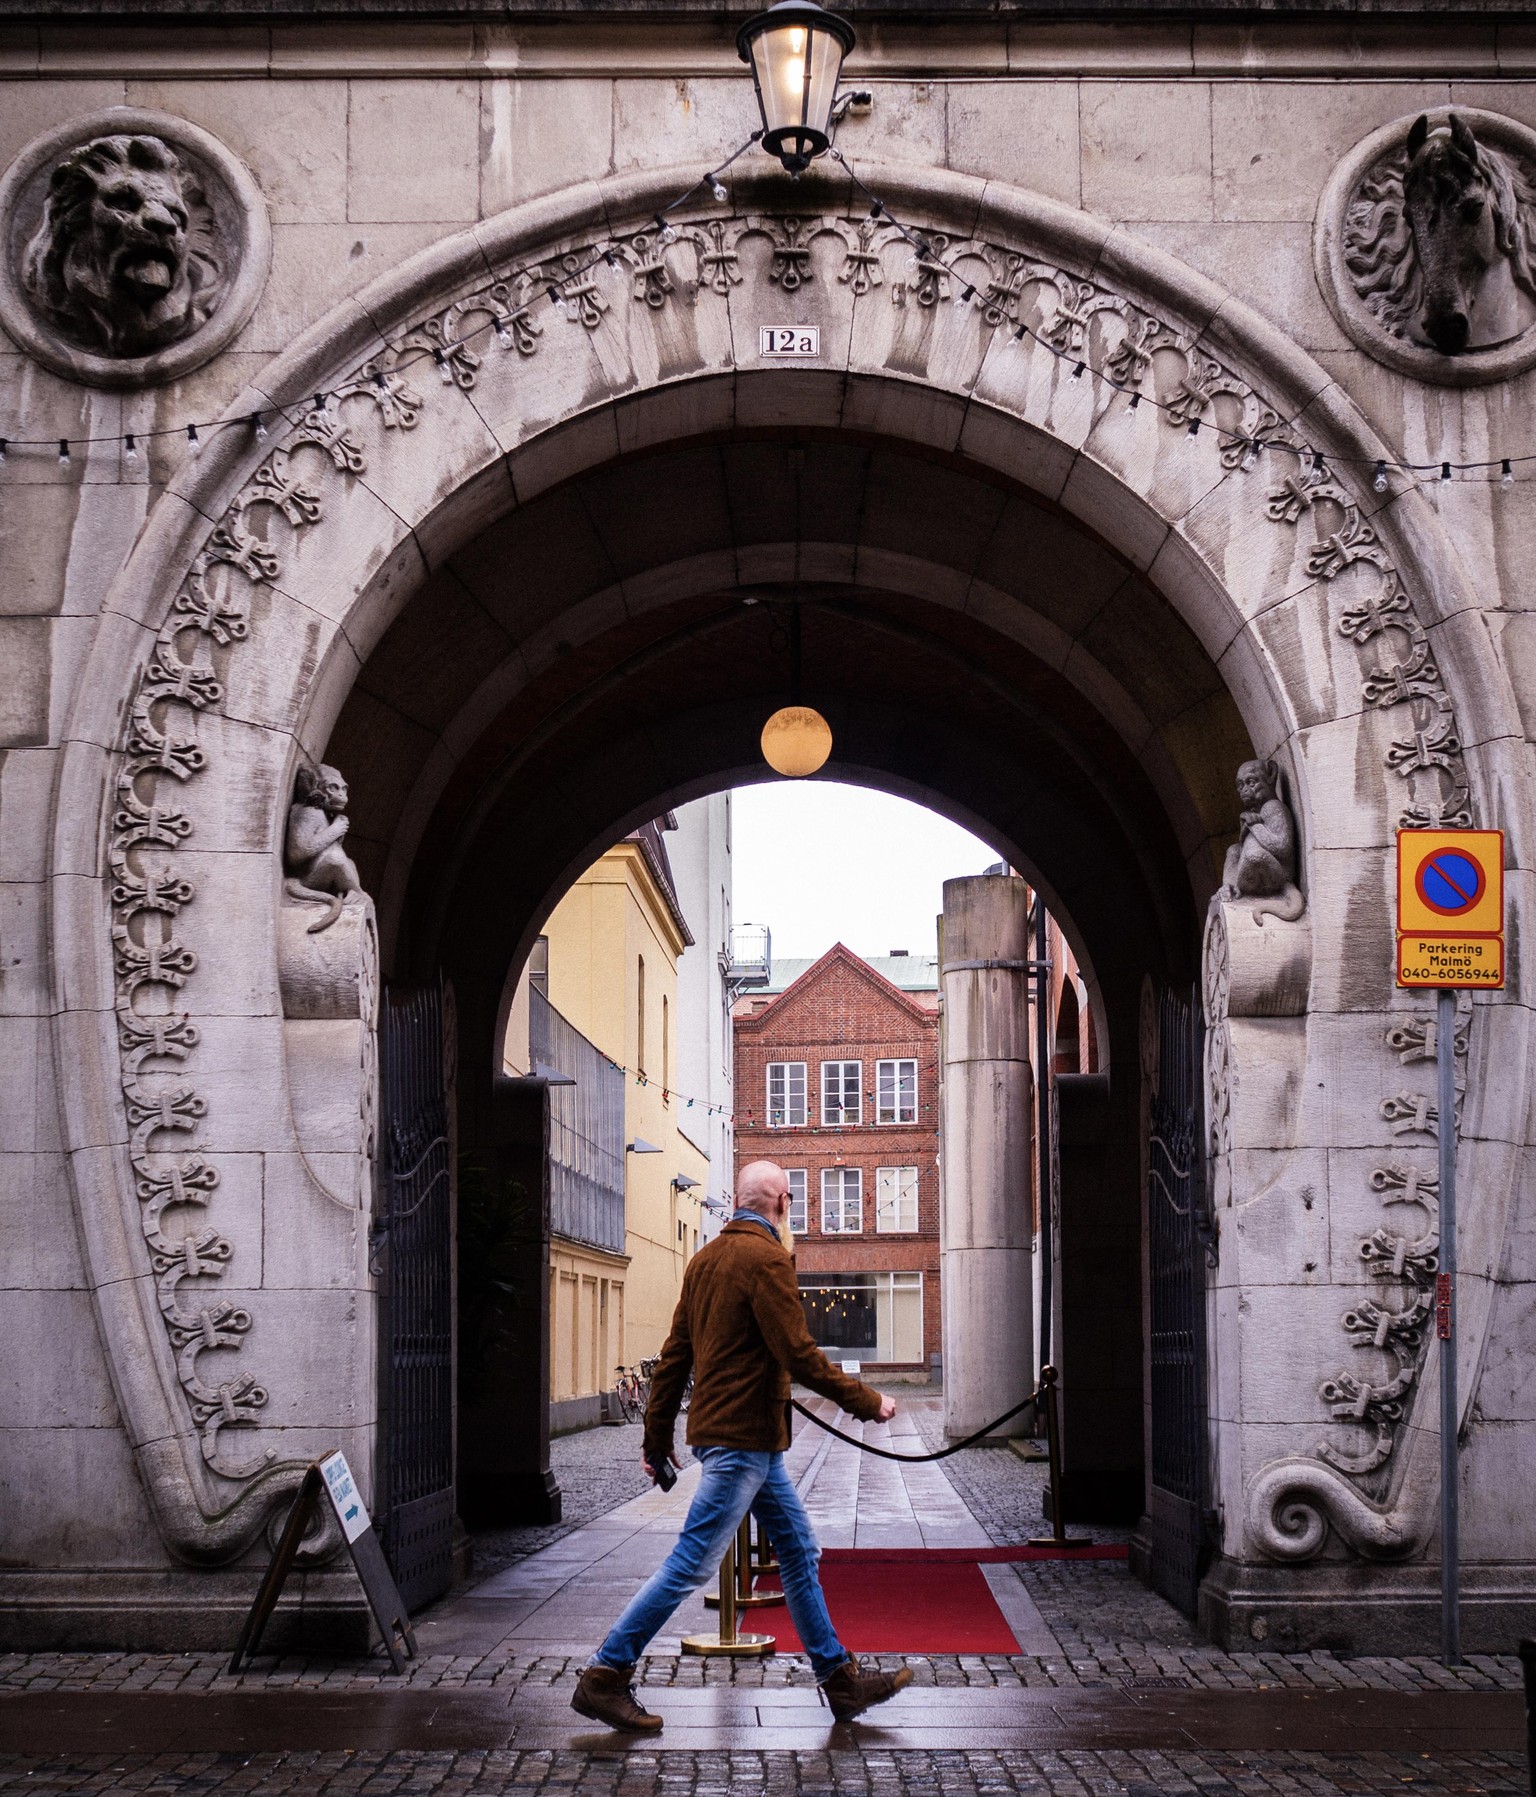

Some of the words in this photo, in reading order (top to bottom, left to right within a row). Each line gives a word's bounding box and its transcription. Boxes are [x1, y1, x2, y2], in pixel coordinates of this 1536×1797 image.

[765, 330, 813, 352] 12a
[1418, 943, 1483, 956] Parkering
[1429, 956, 1472, 966] Malmö
[1402, 967, 1499, 979] 040-6056944
